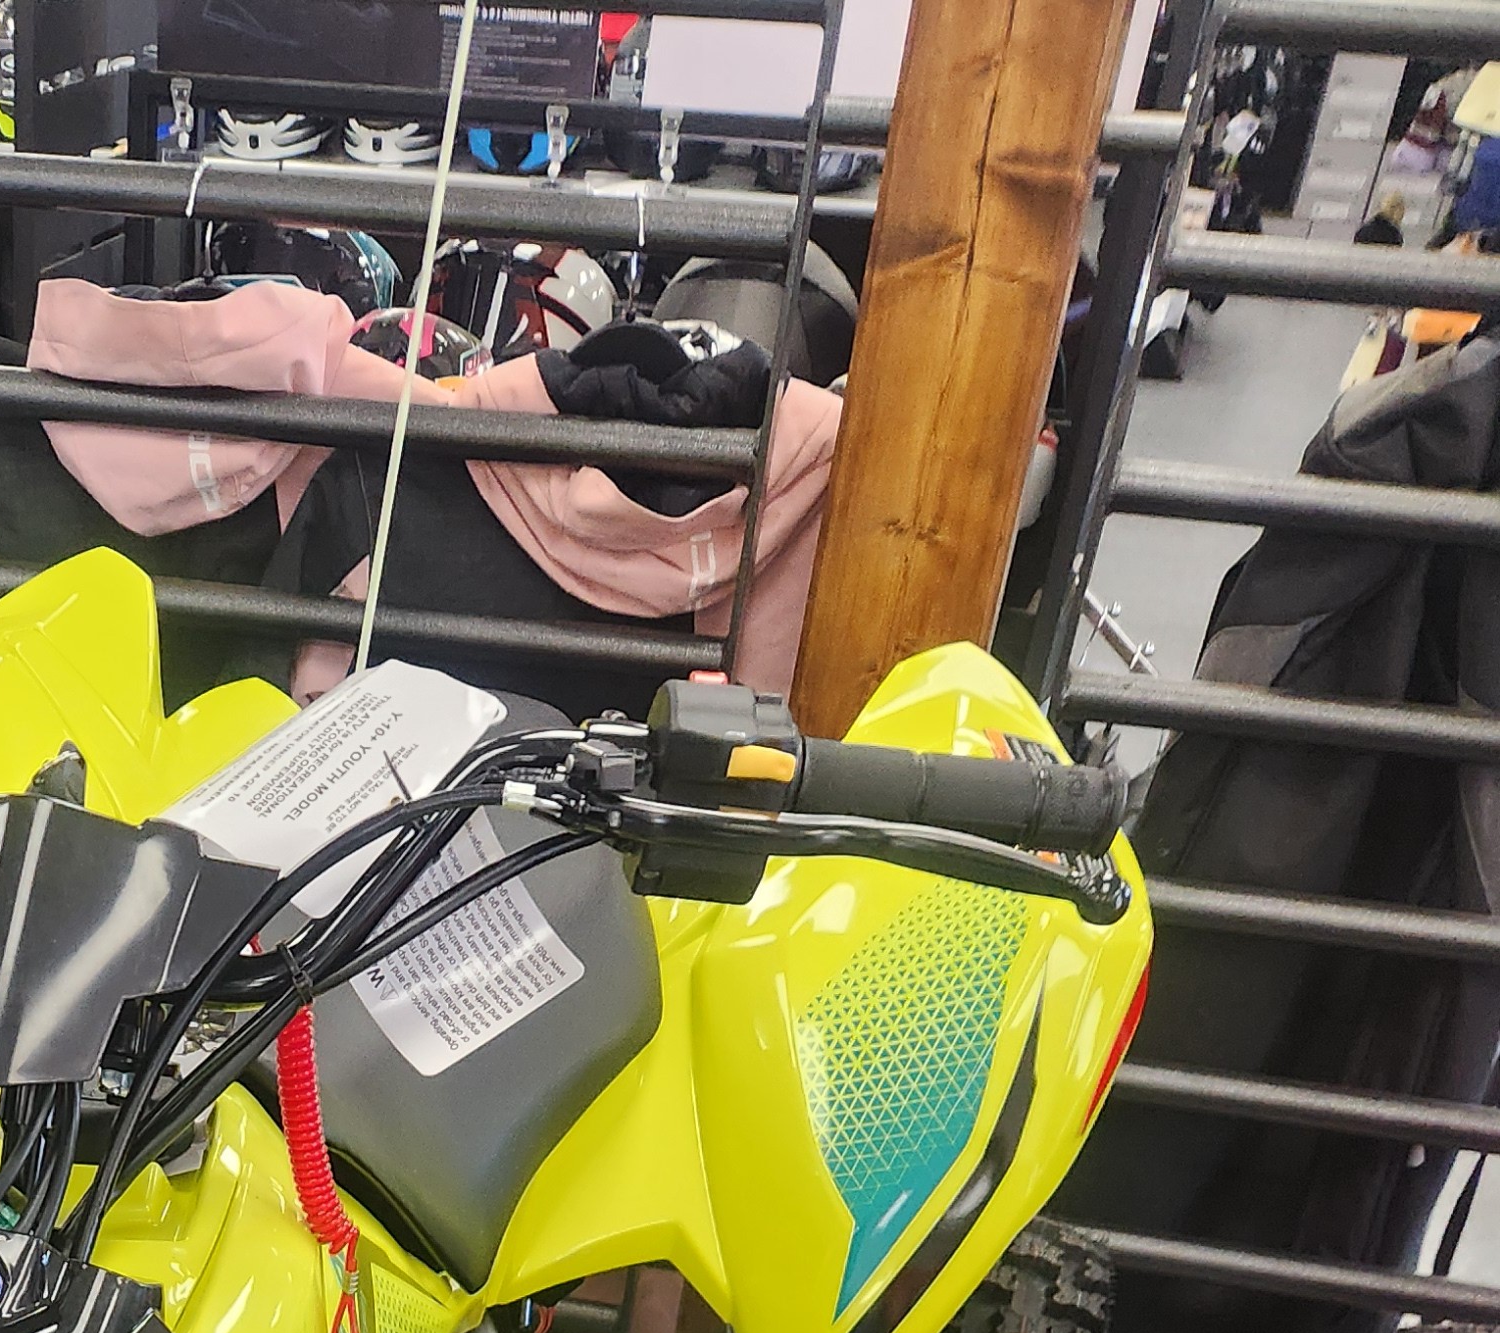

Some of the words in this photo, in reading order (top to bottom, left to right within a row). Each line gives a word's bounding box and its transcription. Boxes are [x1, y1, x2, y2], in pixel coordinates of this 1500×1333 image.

[339, 692, 371, 720] UNDER
[359, 694, 378, 713] USE
[370, 695, 392, 711] This
[344, 713, 358, 727] BY
[352, 712, 370, 731] ATV
[370, 712, 402, 741] Y-10+
[308, 721, 337, 749] ADULT
[309, 728, 344, 758] YOUNG
[341, 730, 353, 738] is
[328, 739, 343, 753] for
[401, 743, 419, 759] THIS
[262, 743, 294, 771] UNDER
[326, 745, 371, 784] YOUTH
[240, 772, 260, 791] AGE
[246, 750, 307, 806] SUPERVISION
[253, 759, 309, 812] OPERATORS
[258, 753, 329, 817] RECREATIONAL
[368, 780, 383, 792] TAG
[227, 793, 240, 802] 10
[345, 779, 373, 804] BEFORE
[283, 783, 328, 820] MODEL
[346, 799, 362, 814] NOT
[326, 804, 345, 821] SALE
[335, 813, 347, 823] TO
[325, 822, 337, 833] BE
[489, 896, 500, 909] go
[466, 912, 481, 930] and
[477, 898, 500, 936] servicing
[432, 933, 449, 955] other
[442, 920, 469, 961] breathing
[478, 931, 494, 951] area
[427, 947, 439, 963] the
[446, 955, 456, 965] or
[527, 954, 544, 973] more
[390, 965, 405, 983] and
[407, 966, 421, 983] can
[415, 954, 437, 983] carbon
[436, 962, 445, 973] to
[516, 959, 545, 993] frequently
[442, 972, 464, 999] knon
[454, 965, 477, 994] defes
[494, 974, 504, 985] as
[541, 973, 556, 986] For
[403, 982, 430, 1018] servicg
[462, 998, 475, 1011] are
[475, 993, 491, 1009] birth
[484, 981, 513, 1014] exposure,
[501, 984, 523, 1006] except
[438, 1010, 463, 1035] off-road
[472, 1009, 491, 1028] which
[487, 1008, 502, 1021] and
[430, 1017, 459, 1050] Operating,
[459, 1014, 481, 1035] engine
[460, 1035, 470, 1043] or
